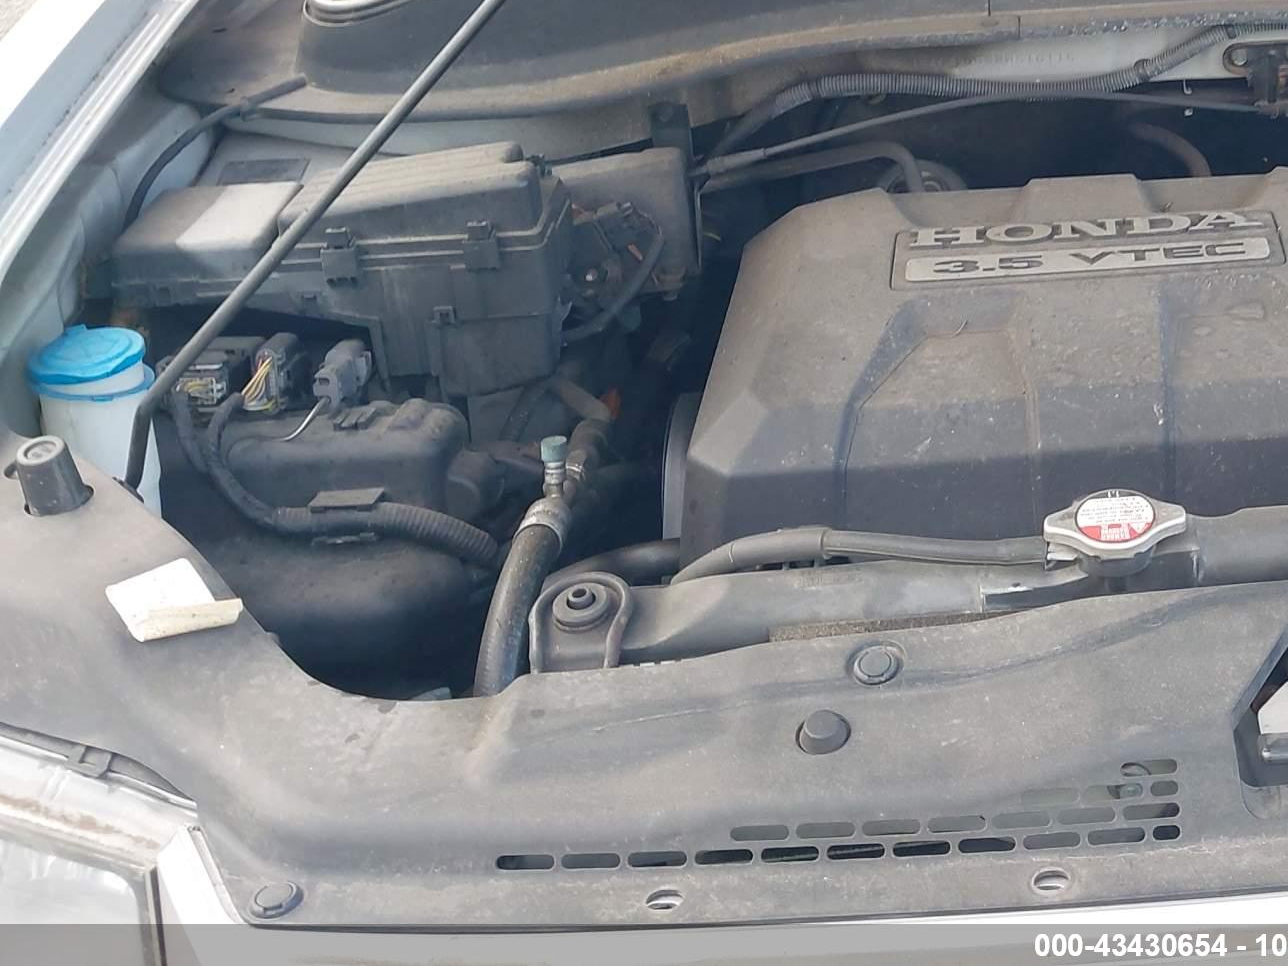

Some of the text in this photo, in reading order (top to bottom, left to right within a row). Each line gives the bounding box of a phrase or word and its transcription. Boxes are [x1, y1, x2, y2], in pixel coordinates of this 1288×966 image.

[908, 210, 1264, 249] HONDA
[932, 241, 1247, 274] 3.5 VTEC
